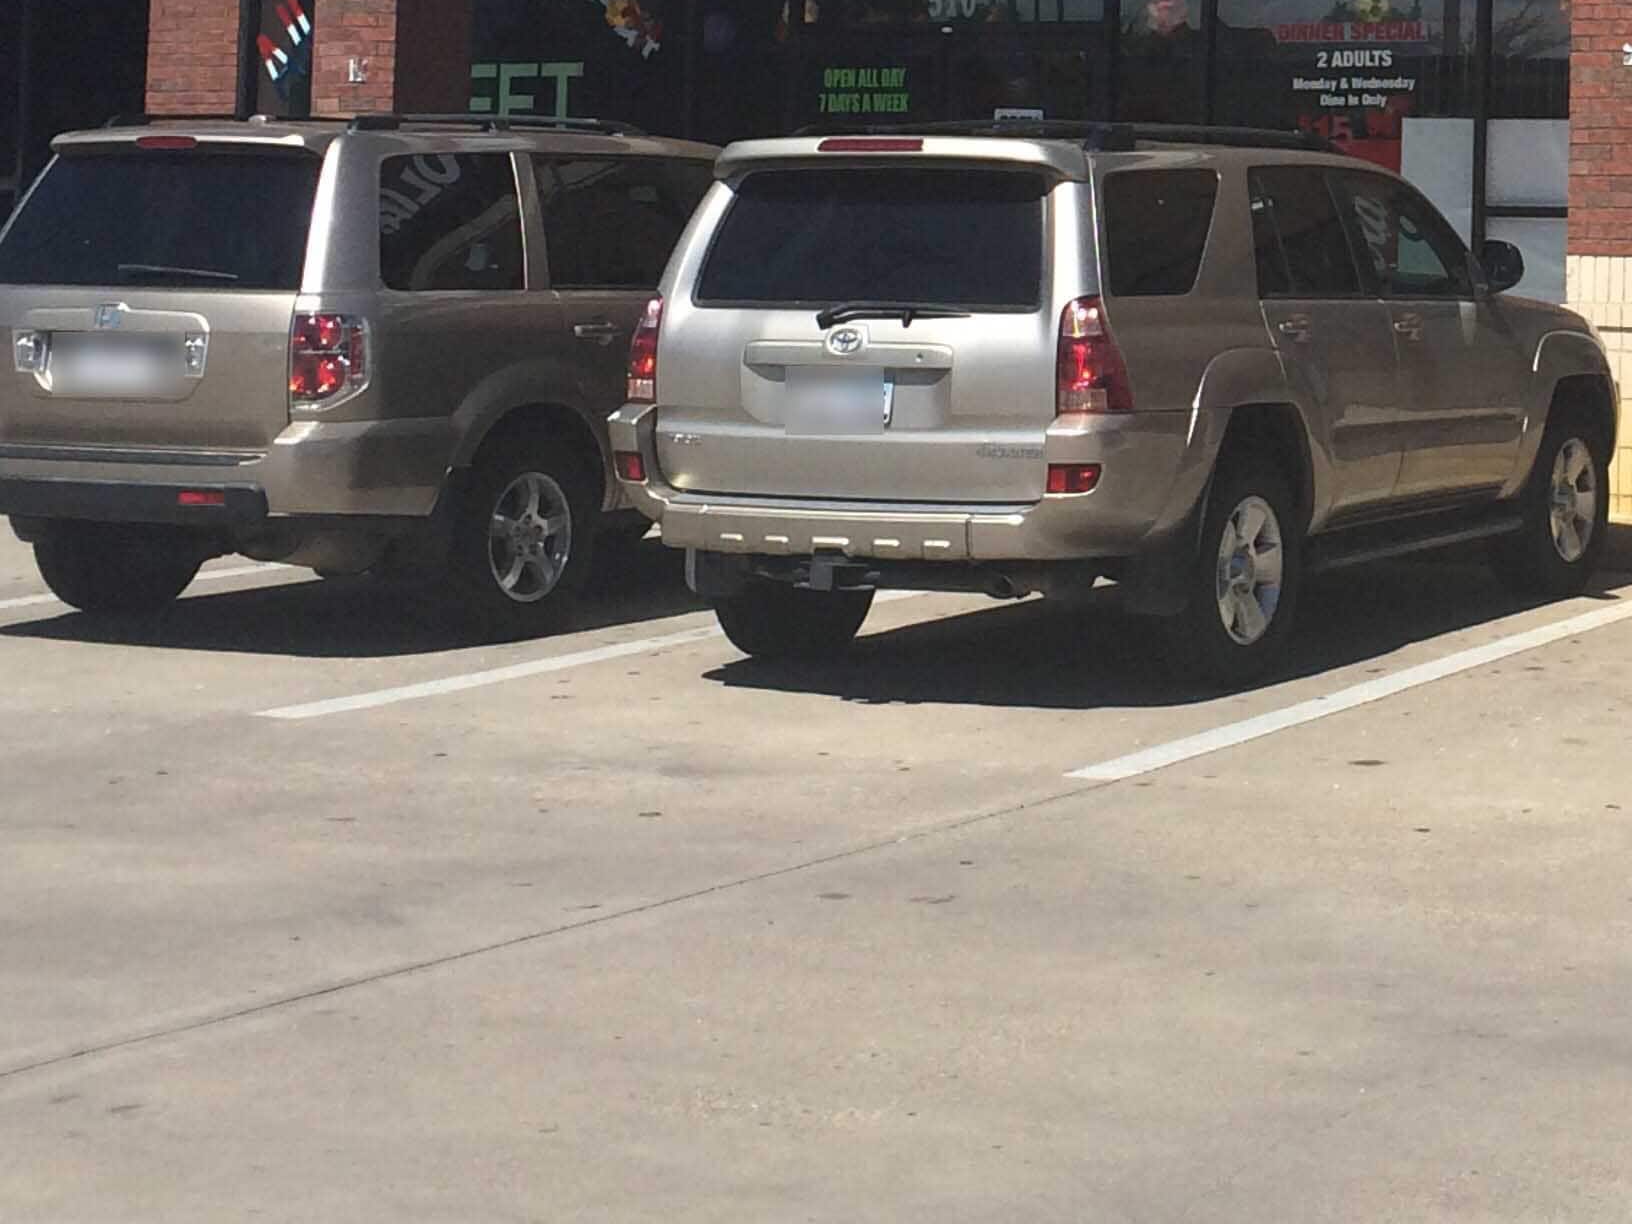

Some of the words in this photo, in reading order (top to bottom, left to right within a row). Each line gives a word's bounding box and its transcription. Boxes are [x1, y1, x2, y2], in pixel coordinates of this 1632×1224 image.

[1350, 21, 1425, 40] SPECIAL
[1316, 51, 1328, 68] 2
[1331, 50, 1393, 67] ADULTS
[824, 68, 855, 88] OPEN
[858, 68, 879, 88] ALL
[881, 68, 907, 88] DAY
[1292, 77, 1338, 92] Monday
[1339, 77, 1349, 90] &
[1351, 76, 1416, 91] Wednesday
[818, 93, 827, 113] 7
[828, 93, 860, 113] DAYS
[861, 93, 872, 113] A
[872, 93, 909, 113] WEEK
[1319, 94, 1345, 106] Dine
[1361, 93, 1388, 108] Only
